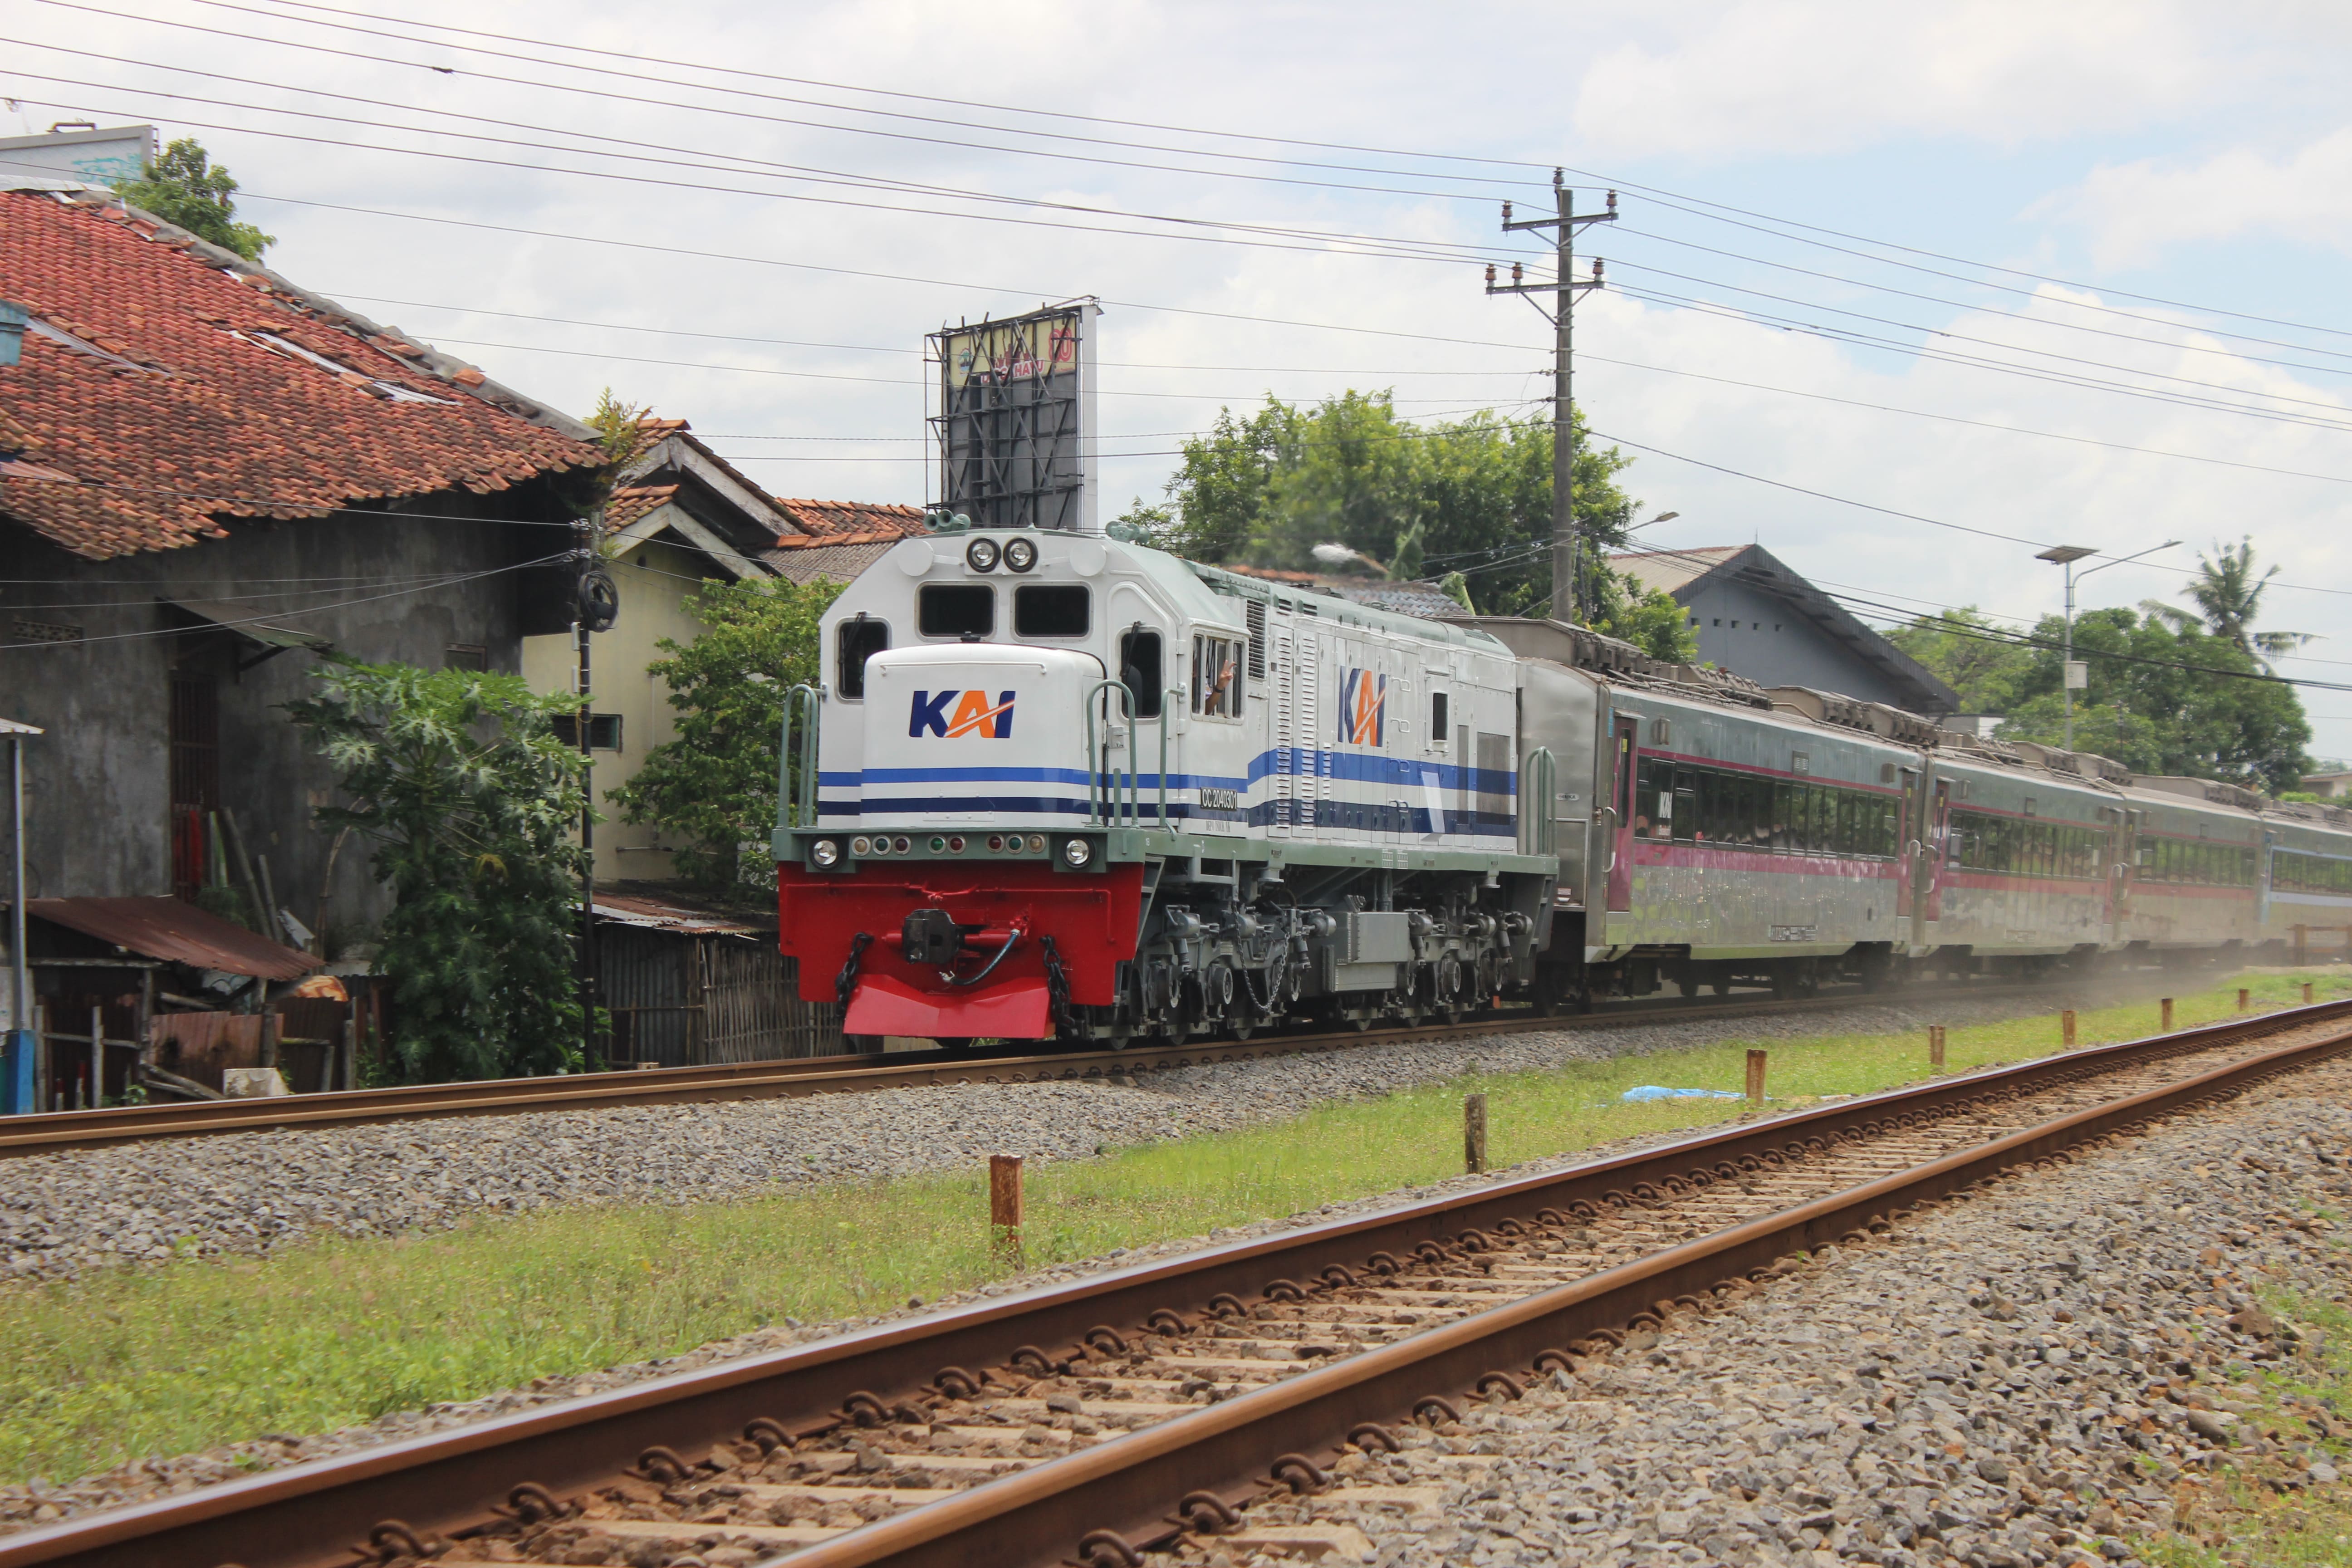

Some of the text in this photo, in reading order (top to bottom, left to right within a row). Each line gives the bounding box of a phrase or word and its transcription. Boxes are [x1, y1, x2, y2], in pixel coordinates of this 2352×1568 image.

[909, 691, 1016, 738] KAI
[1338, 665, 1386, 747] KAI
[1202, 789, 1237, 809] CC 2040301
